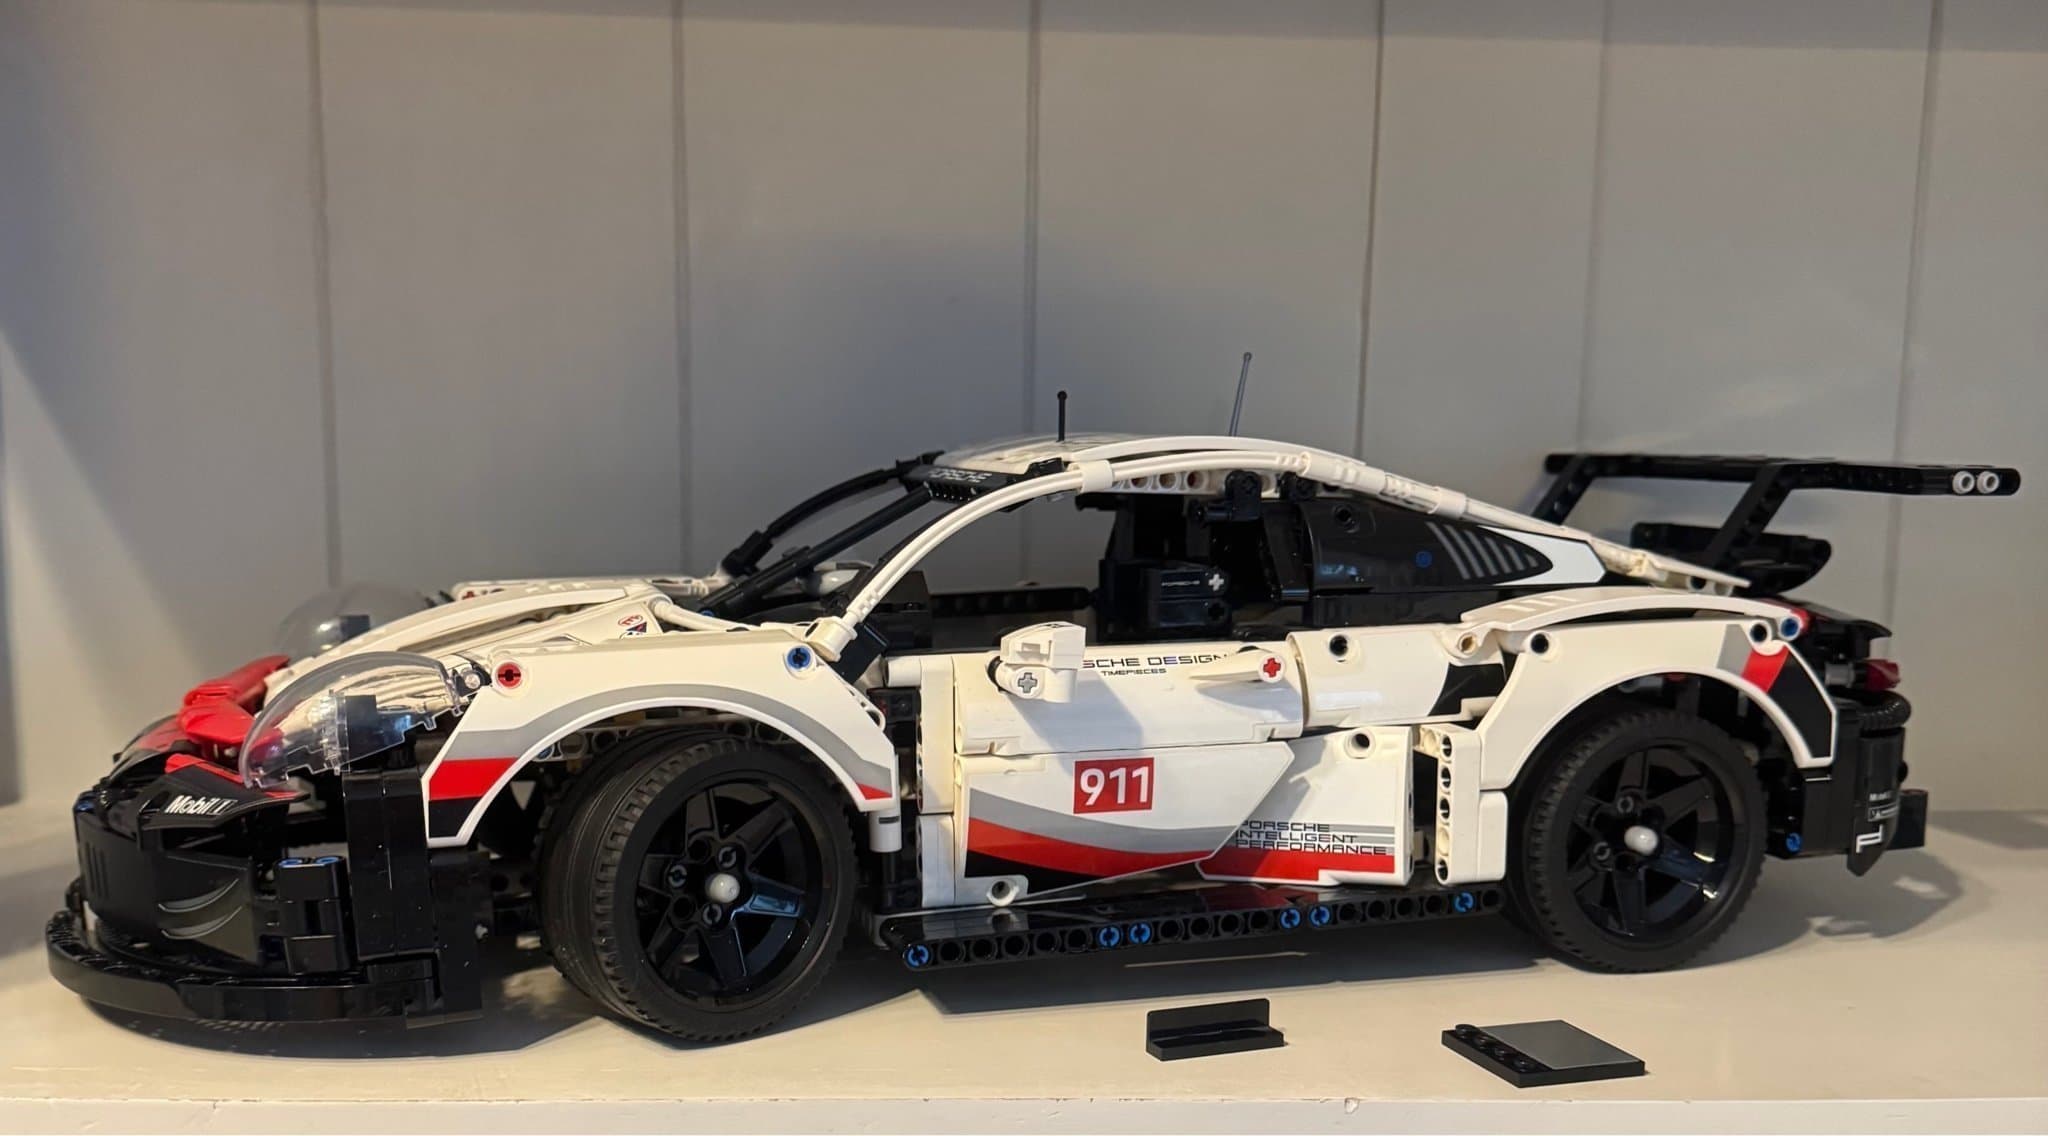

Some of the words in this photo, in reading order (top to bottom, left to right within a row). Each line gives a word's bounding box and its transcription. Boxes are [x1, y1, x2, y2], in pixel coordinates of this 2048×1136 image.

[1082, 657, 1141, 669] SCHE
[1080, 766, 1149, 806] 911
[164, 795, 220, 815] Mobil
[1235, 830, 1358, 844] INTELLIGENT
[1235, 839, 1387, 856] PERFORMANCE
